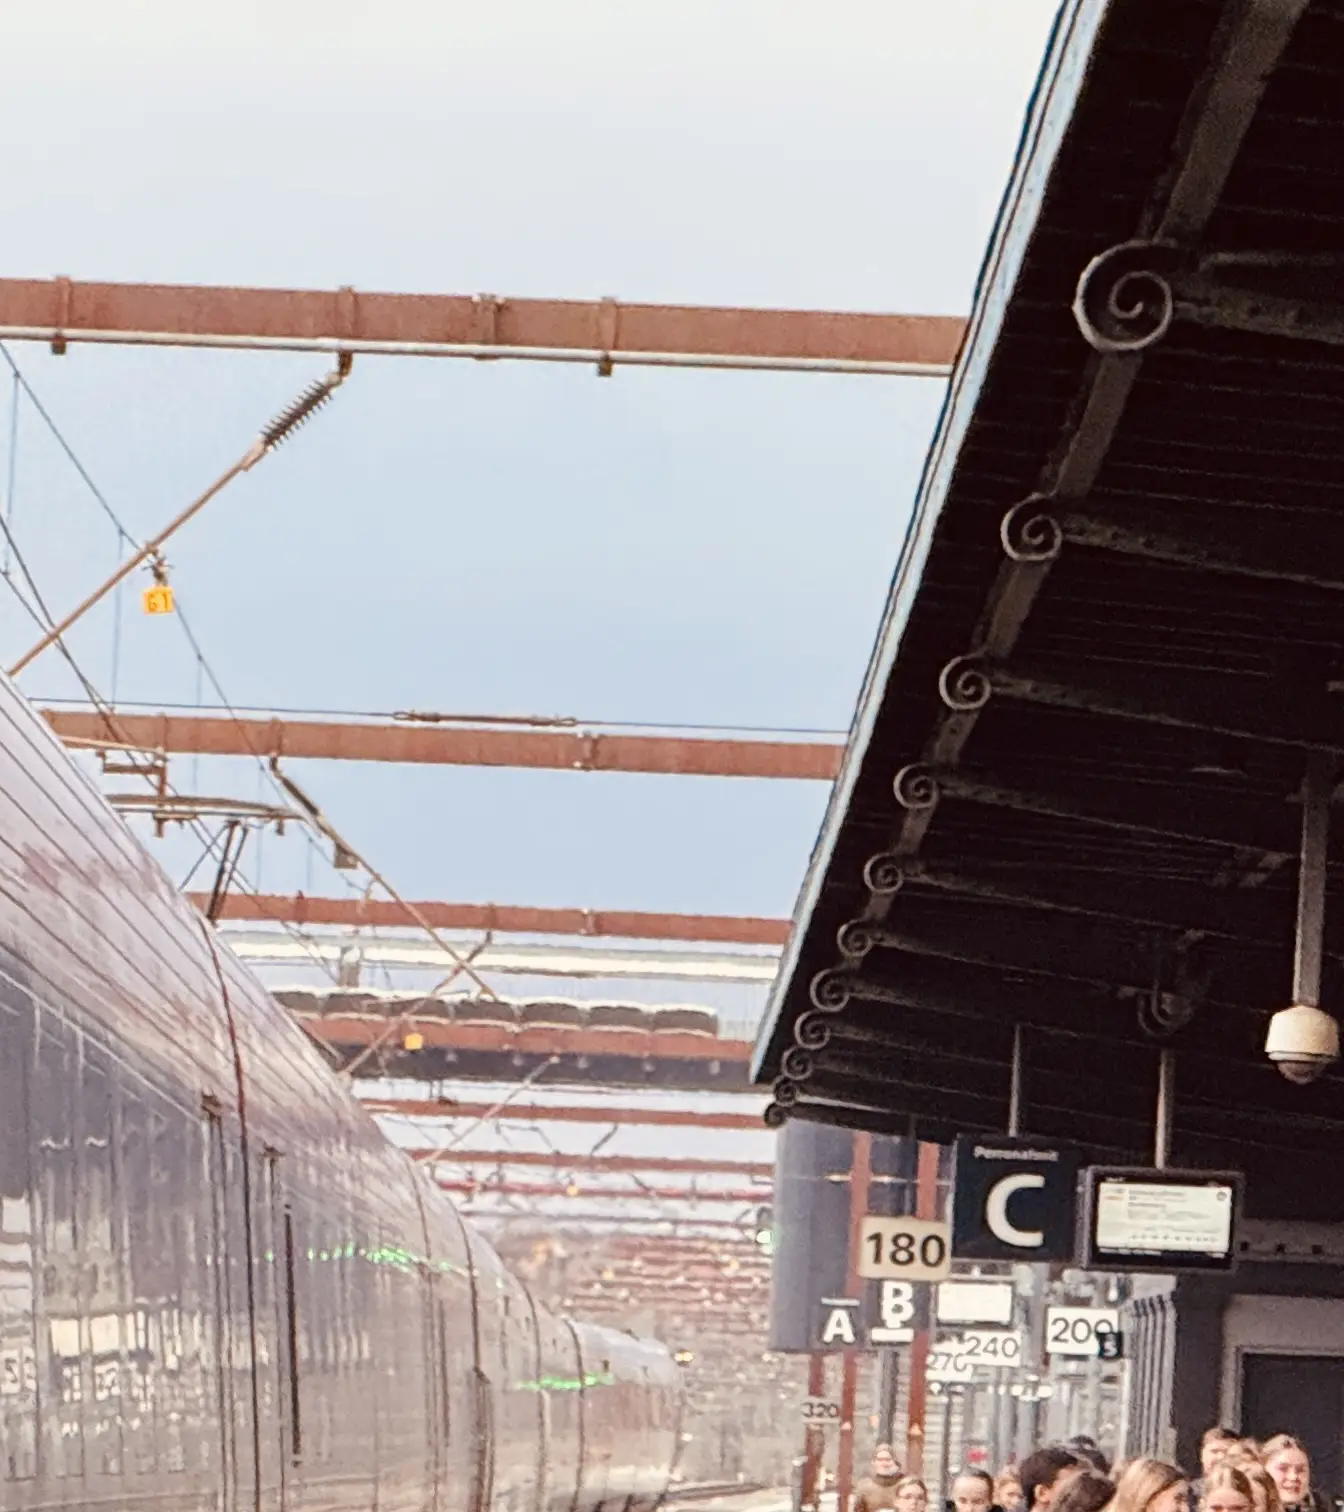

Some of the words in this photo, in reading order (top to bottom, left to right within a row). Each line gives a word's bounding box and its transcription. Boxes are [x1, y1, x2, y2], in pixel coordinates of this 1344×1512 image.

[986, 1173, 1045, 1248] C
[867, 1232, 946, 1268] 180
[881, 1281, 914, 1322] B
[823, 1308, 855, 1342] A
[927, 1352, 967, 1373] 270
[966, 1336, 1019, 1358] 240
[800, 1402, 840, 1418] 320
